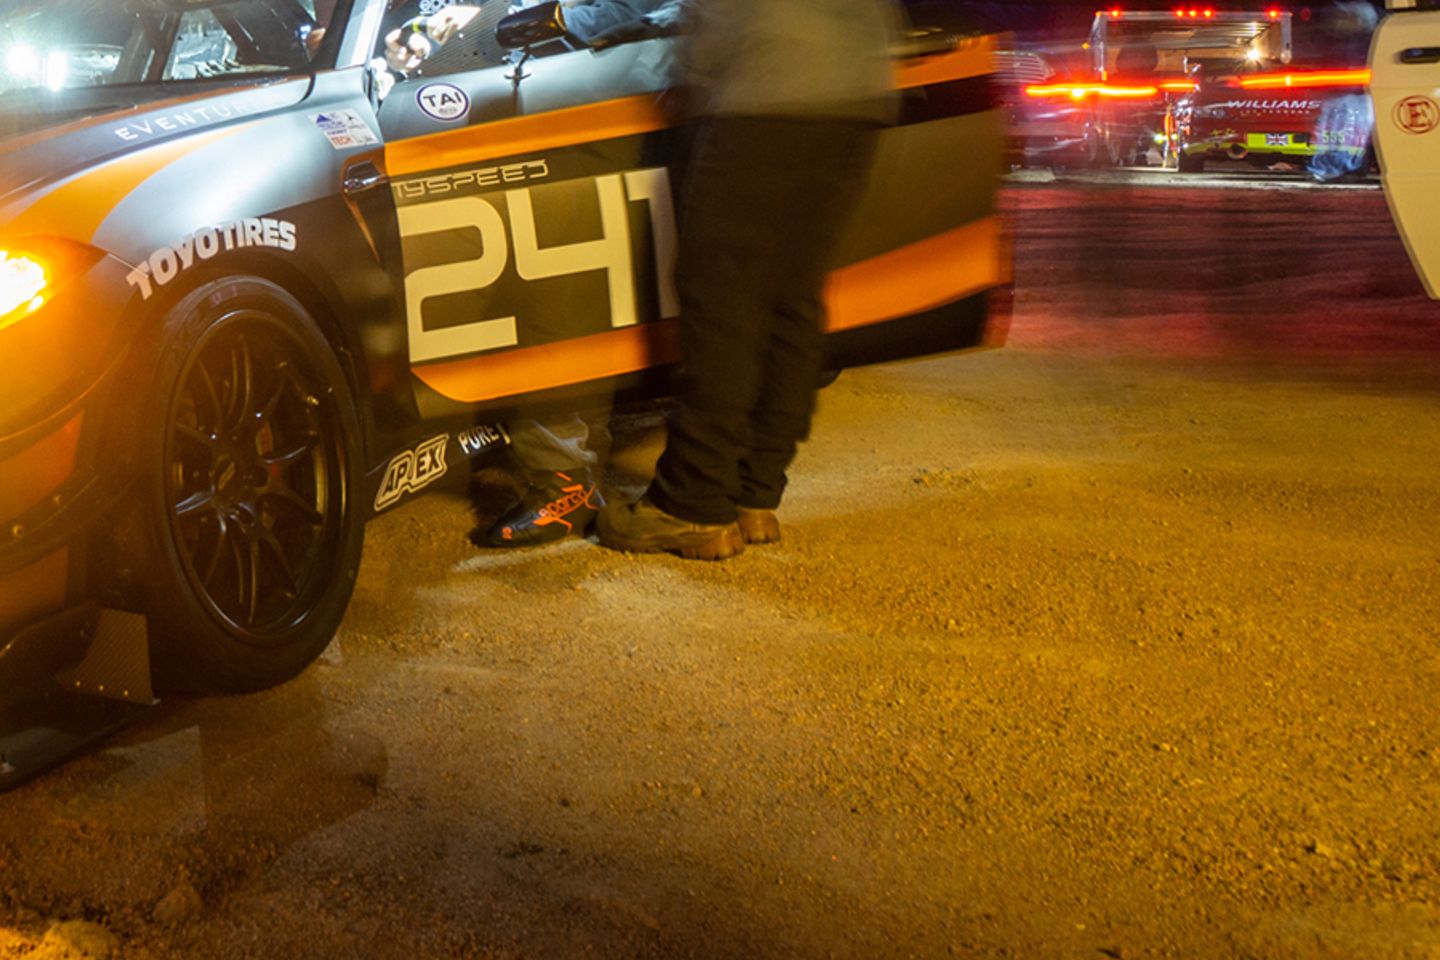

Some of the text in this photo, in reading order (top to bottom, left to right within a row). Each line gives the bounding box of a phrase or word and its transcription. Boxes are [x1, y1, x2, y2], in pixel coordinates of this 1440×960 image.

[114, 102, 260, 141] EVENTUR
[1227, 100, 1323, 109] WILLIAMS
[396, 167, 680, 362] 241
[378, 439, 445, 503] APEX
